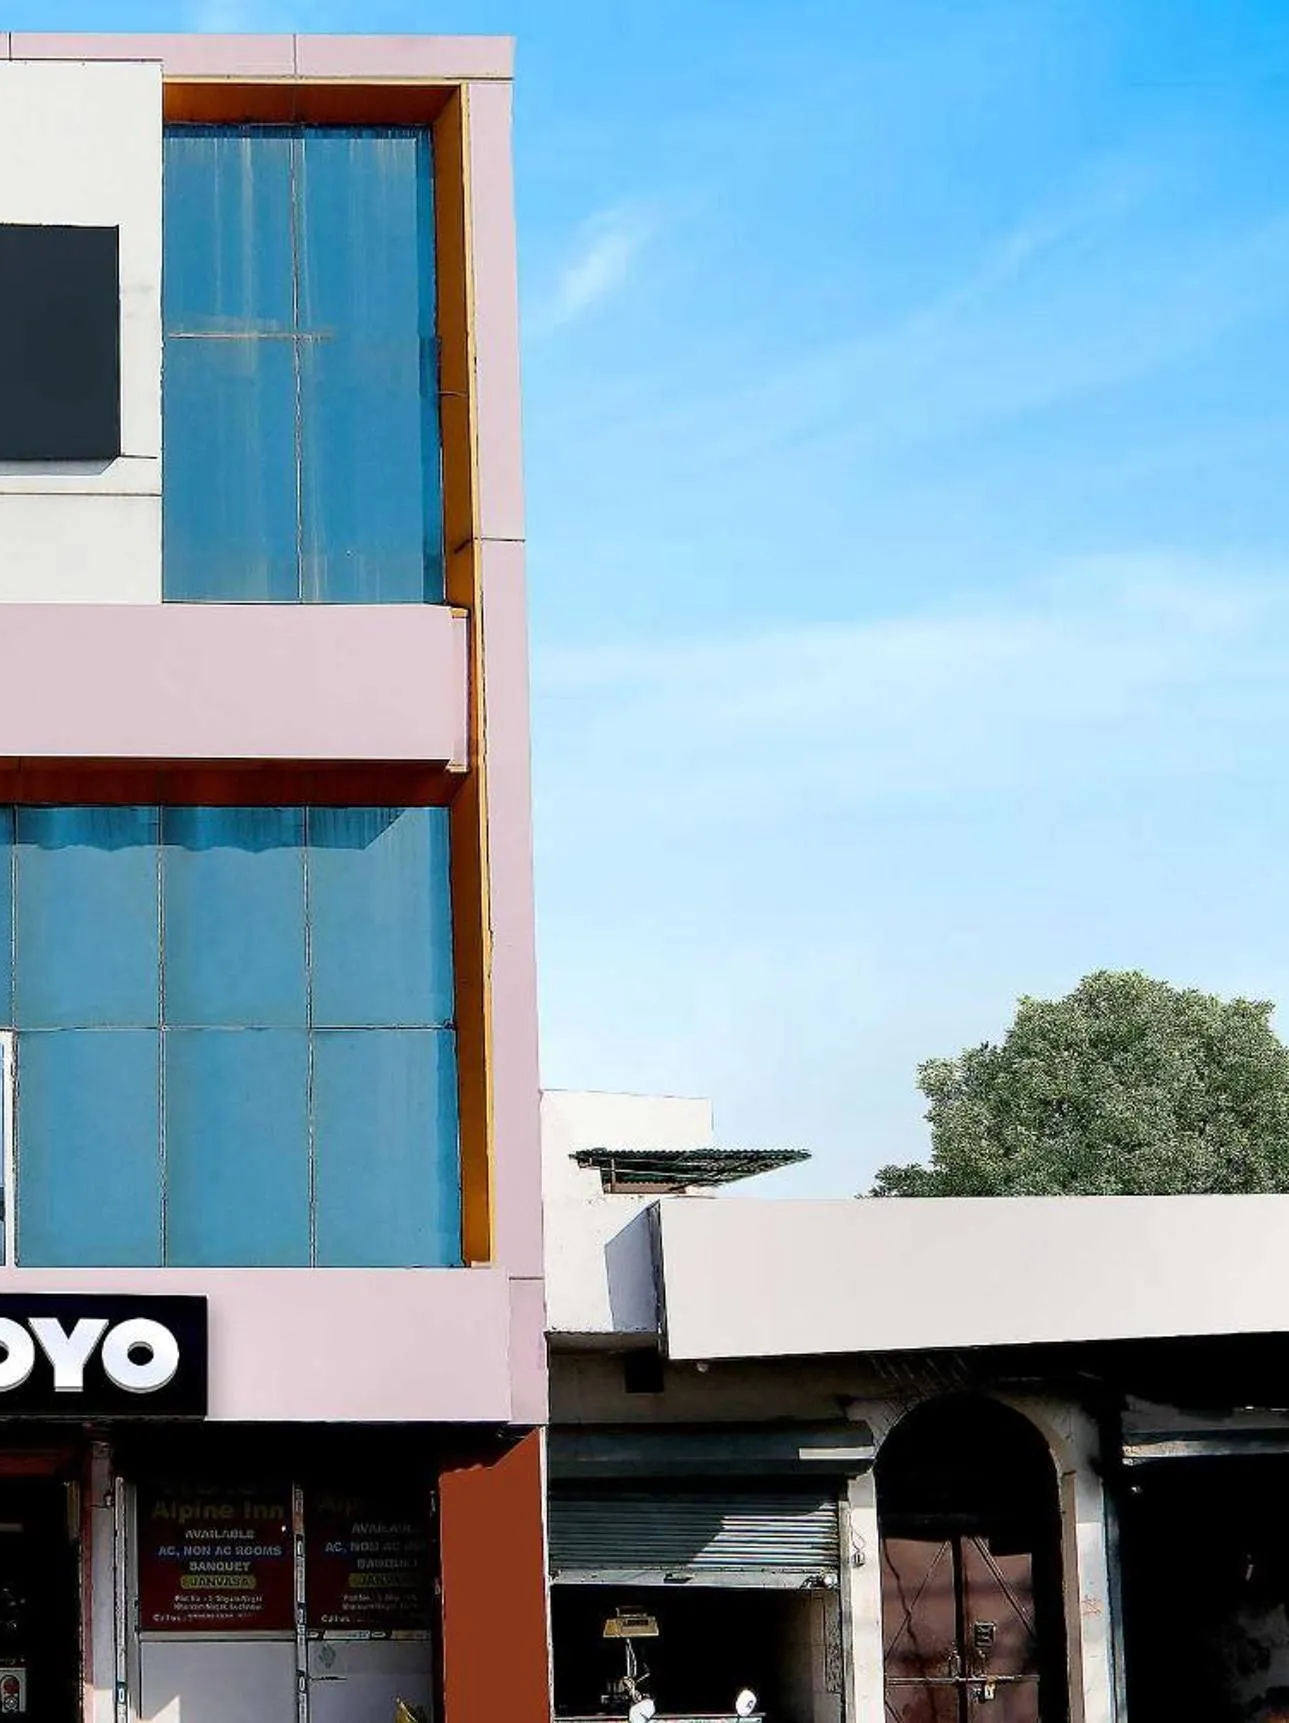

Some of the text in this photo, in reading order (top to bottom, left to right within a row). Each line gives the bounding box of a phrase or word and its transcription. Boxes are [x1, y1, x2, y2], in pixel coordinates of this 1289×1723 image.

[151, 1499, 285, 1524] Alpine Inn
[184, 1528, 256, 1540] AVAILABLE
[183, 1545, 211, 1556] NON
[214, 1545, 232, 1556] AC
[235, 1545, 283, 1556] ROOMS
[188, 1560, 252, 1573] BANQUET
